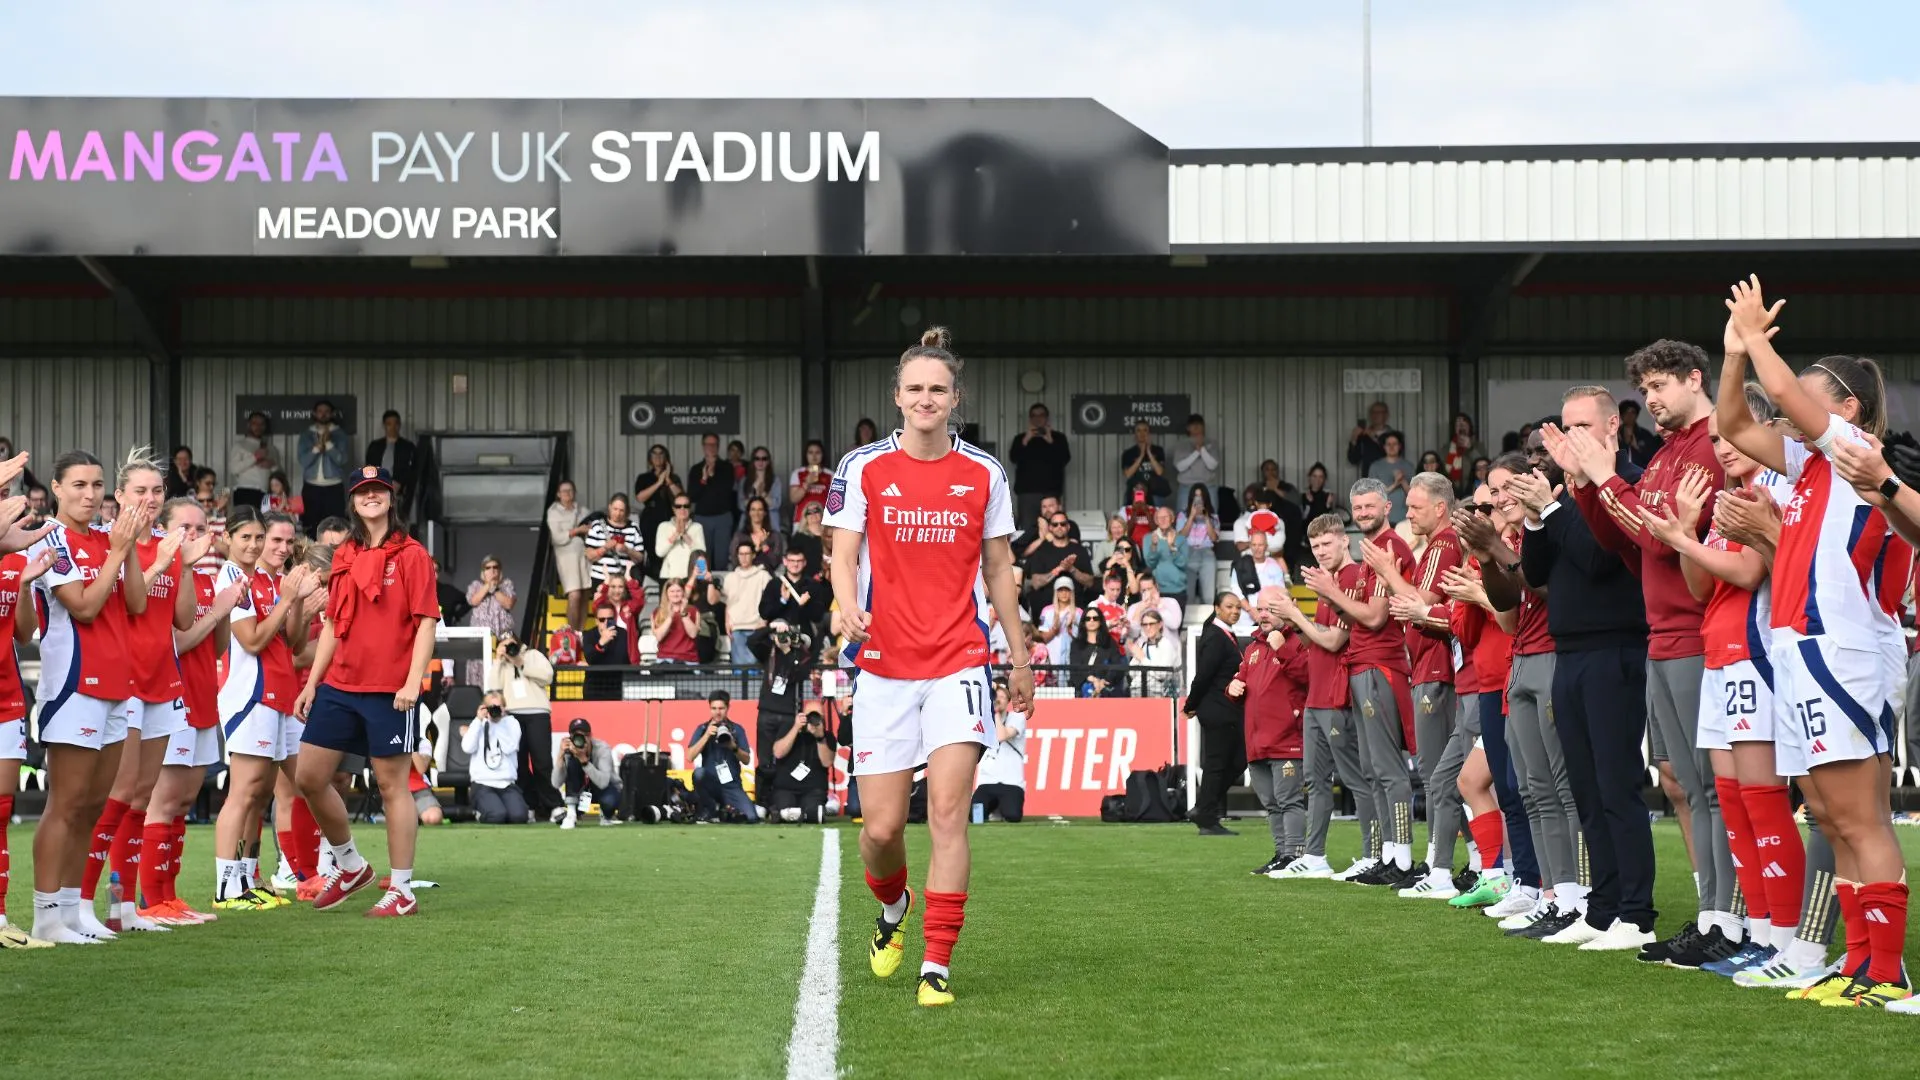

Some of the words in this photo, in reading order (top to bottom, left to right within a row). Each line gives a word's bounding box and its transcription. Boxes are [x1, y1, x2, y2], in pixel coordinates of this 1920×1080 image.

[9, 130, 348, 183] MANGATA
[372, 131, 475, 182] PAY
[491, 131, 572, 183] UK
[590, 130, 880, 183] STADIUM
[258, 207, 441, 239] MEADOW
[453, 207, 558, 239] PARK
[1345, 371, 1405, 391] BLOCK
[1411, 371, 1421, 391] B
[664, 406, 690, 415] HOME
[692, 406, 698, 415] &
[701, 406, 727, 415] AWAY
[1132, 402, 1163, 413] PRESS
[672, 416, 719, 425] DIRECTORS
[1124, 415, 1171, 427] SETING
[883, 506, 968, 527] Emirates
[895, 528, 912, 543] FLY
[916, 528, 956, 543] BETTER
[147, 585, 169, 599] ETTER
[960, 680, 982, 717] 11
[1725, 680, 1757, 716] 29
[1796, 697, 1826, 740] 15
[1024, 728, 1138, 791] TTER
[1757, 835, 1781, 848] AFC
